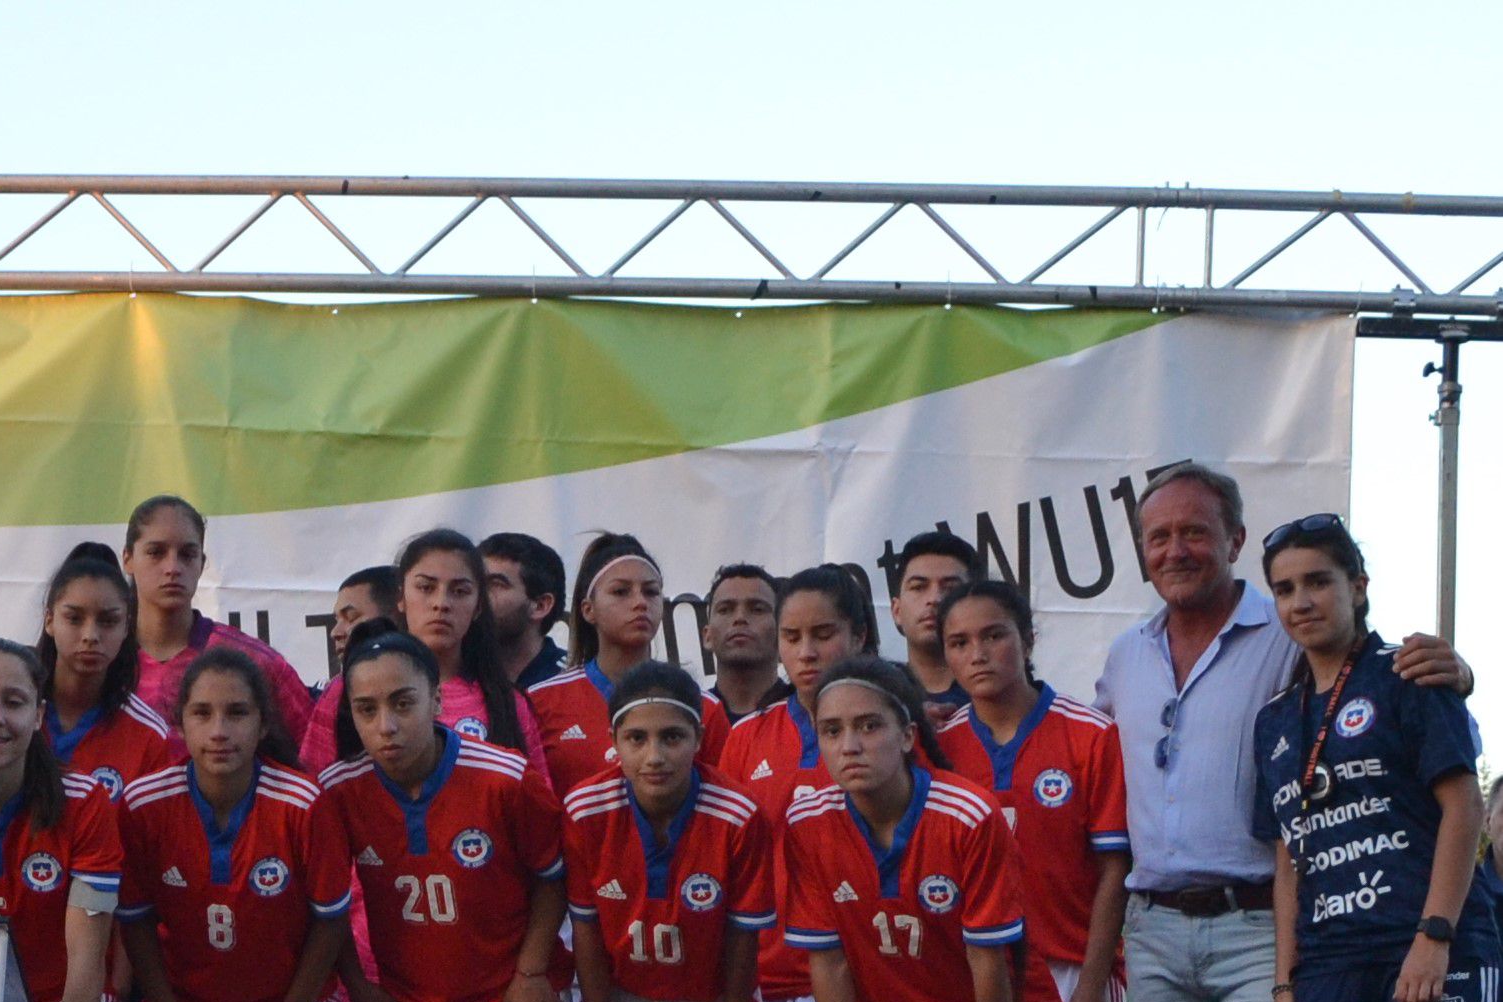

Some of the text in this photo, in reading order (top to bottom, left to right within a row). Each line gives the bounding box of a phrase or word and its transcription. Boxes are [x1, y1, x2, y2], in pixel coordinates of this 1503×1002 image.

[935, 458, 1193, 606] WU1
[1291, 795, 1391, 840] Santander
[394, 873, 458, 924] 20
[1312, 878, 1384, 923] Claro
[206, 903, 236, 950] 8
[627, 919, 685, 963] 10
[872, 911, 921, 958] 17
